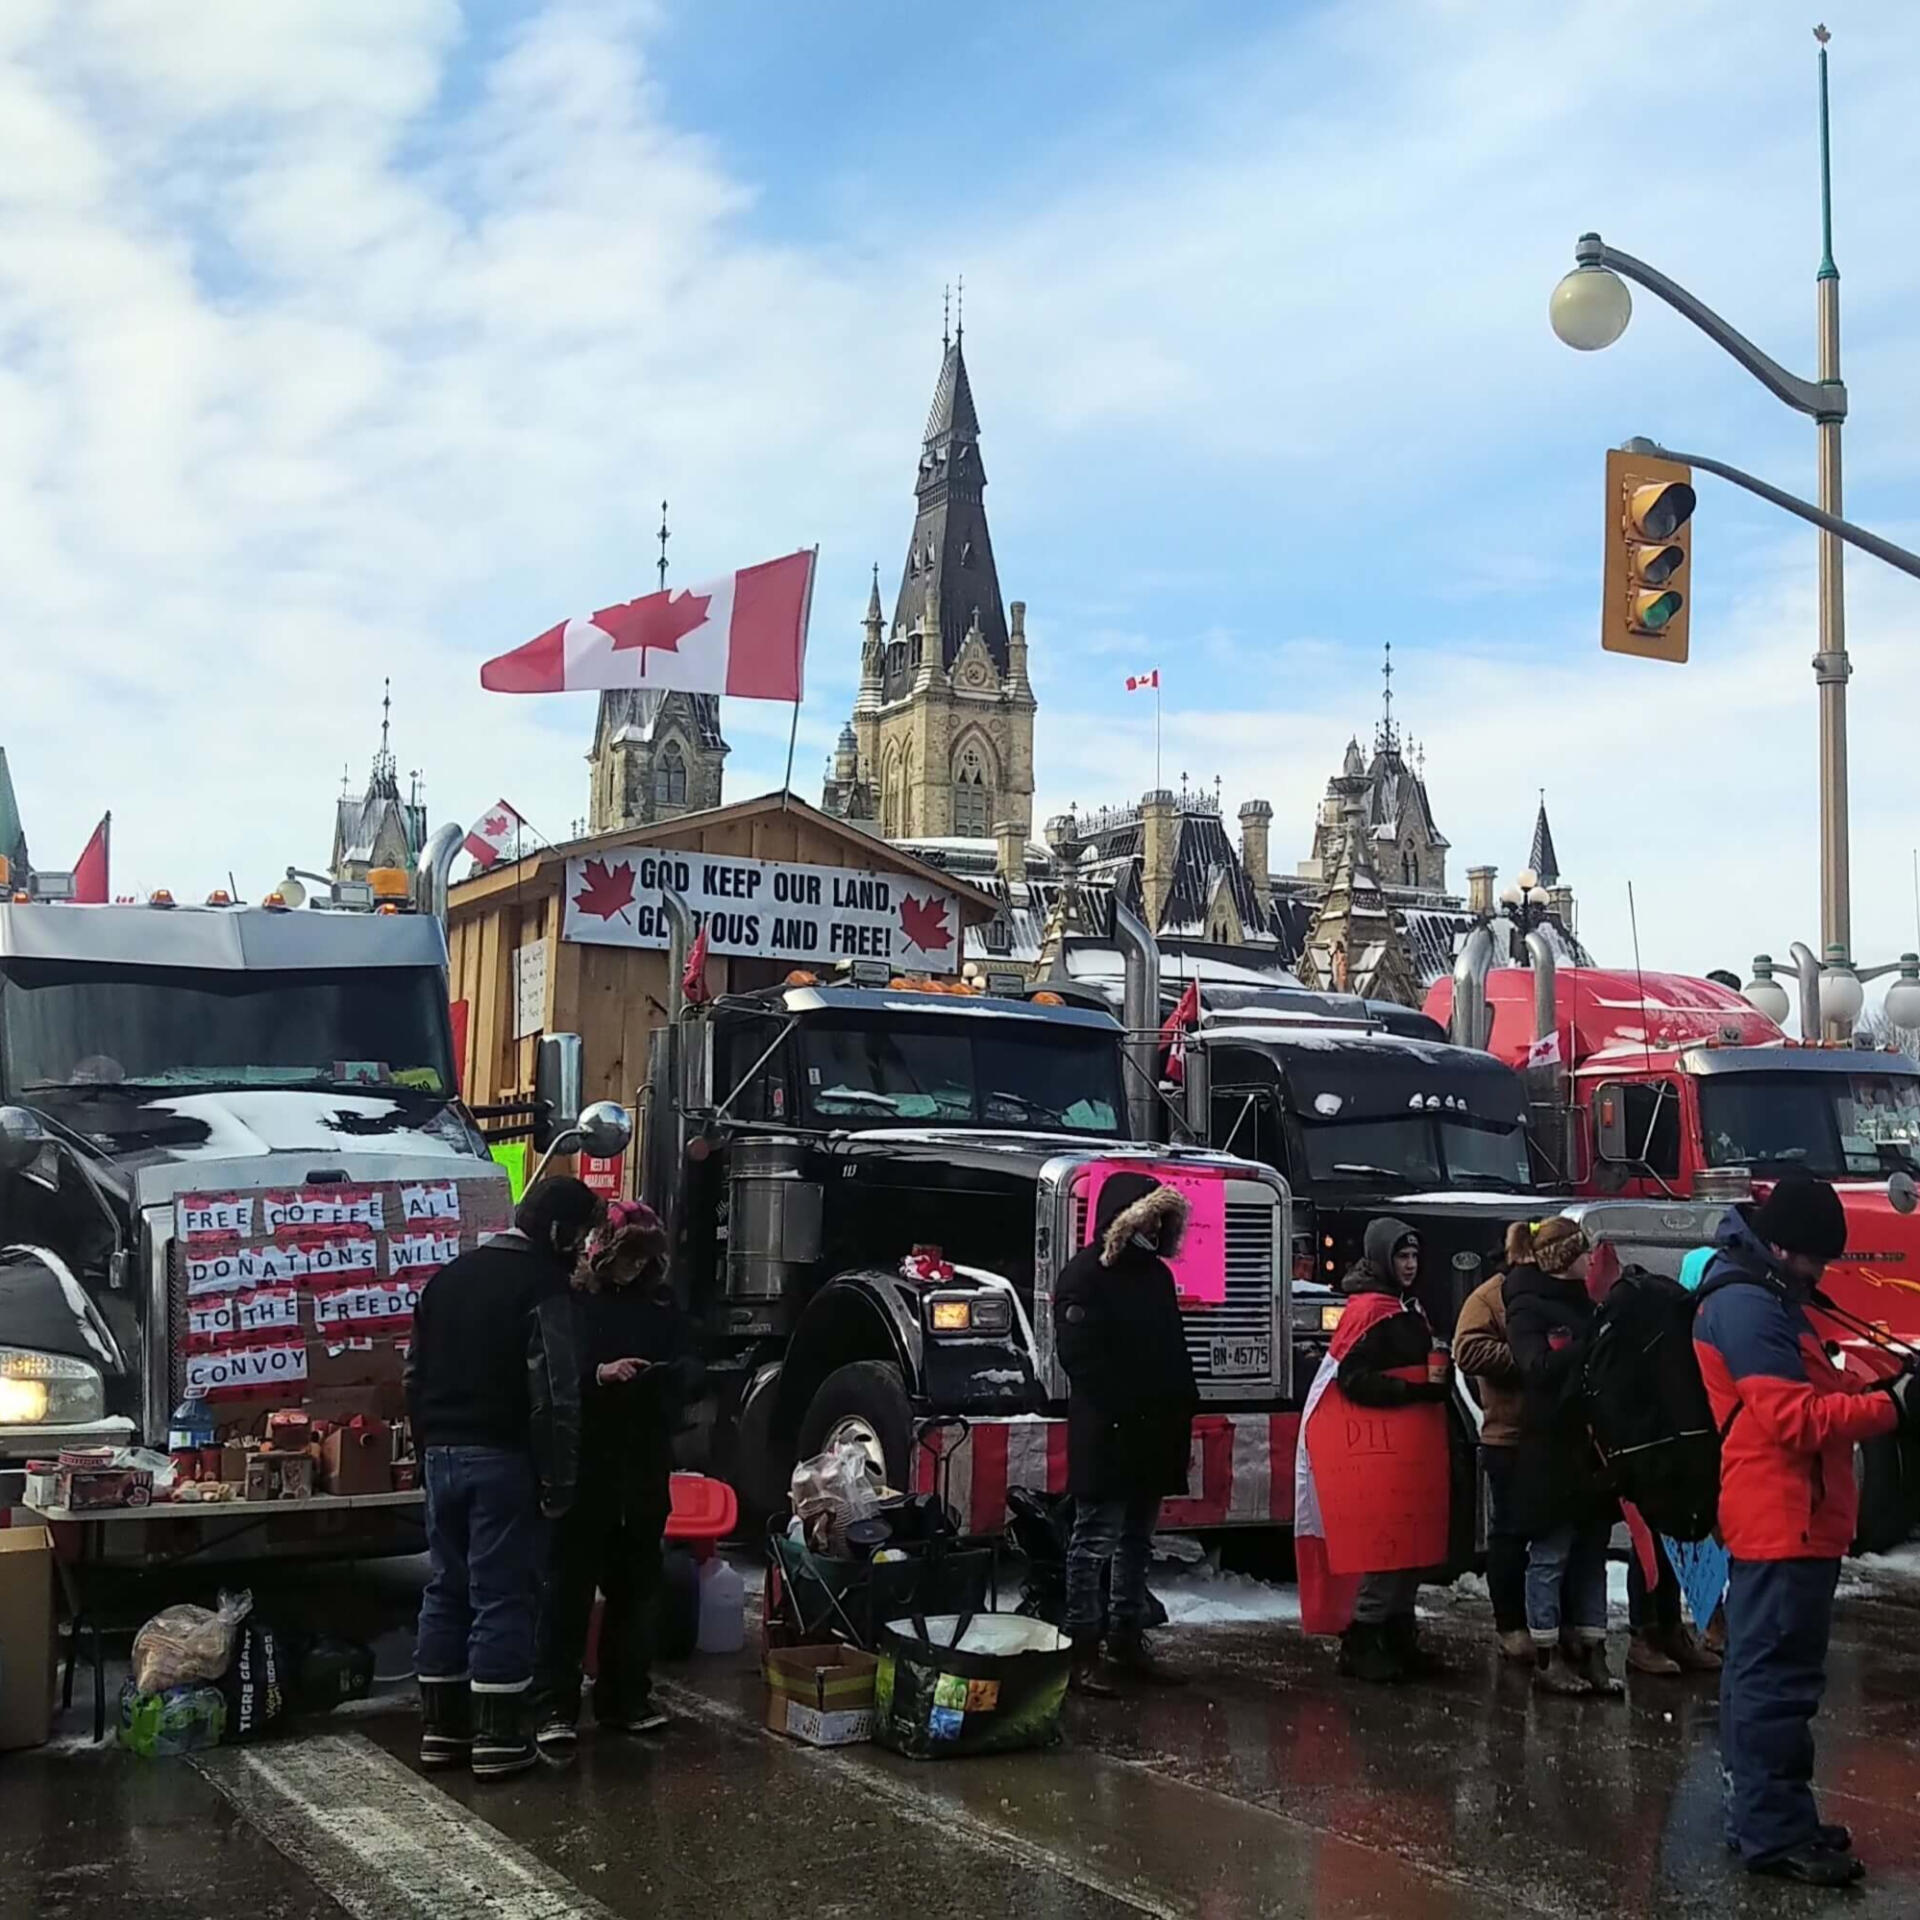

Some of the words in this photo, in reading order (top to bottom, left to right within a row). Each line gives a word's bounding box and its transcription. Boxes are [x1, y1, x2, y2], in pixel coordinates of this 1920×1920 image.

[640, 858, 689, 892] GOD
[703, 865, 761, 899] KEEP
[774, 872, 821, 905] OUR
[833, 877, 897, 916] LAND,
[638, 905, 760, 945] GLROUS
[771, 919, 818, 951] AND
[829, 923, 891, 957] FREE!
[186, 1207, 247, 1229] FREE
[409, 1193, 457, 1217] ALL
[193, 1246, 372, 1280] DONATIONS
[392, 1242, 457, 1265] WILL
[196, 1309, 230, 1330] TO
[244, 1299, 296, 1326] THE
[320, 1289, 420, 1320] FREEDO
[191, 1350, 305, 1386] CONVOY
[238, 1628, 252, 1681] GÉANT
[239, 1683, 254, 1733] TIGRE
